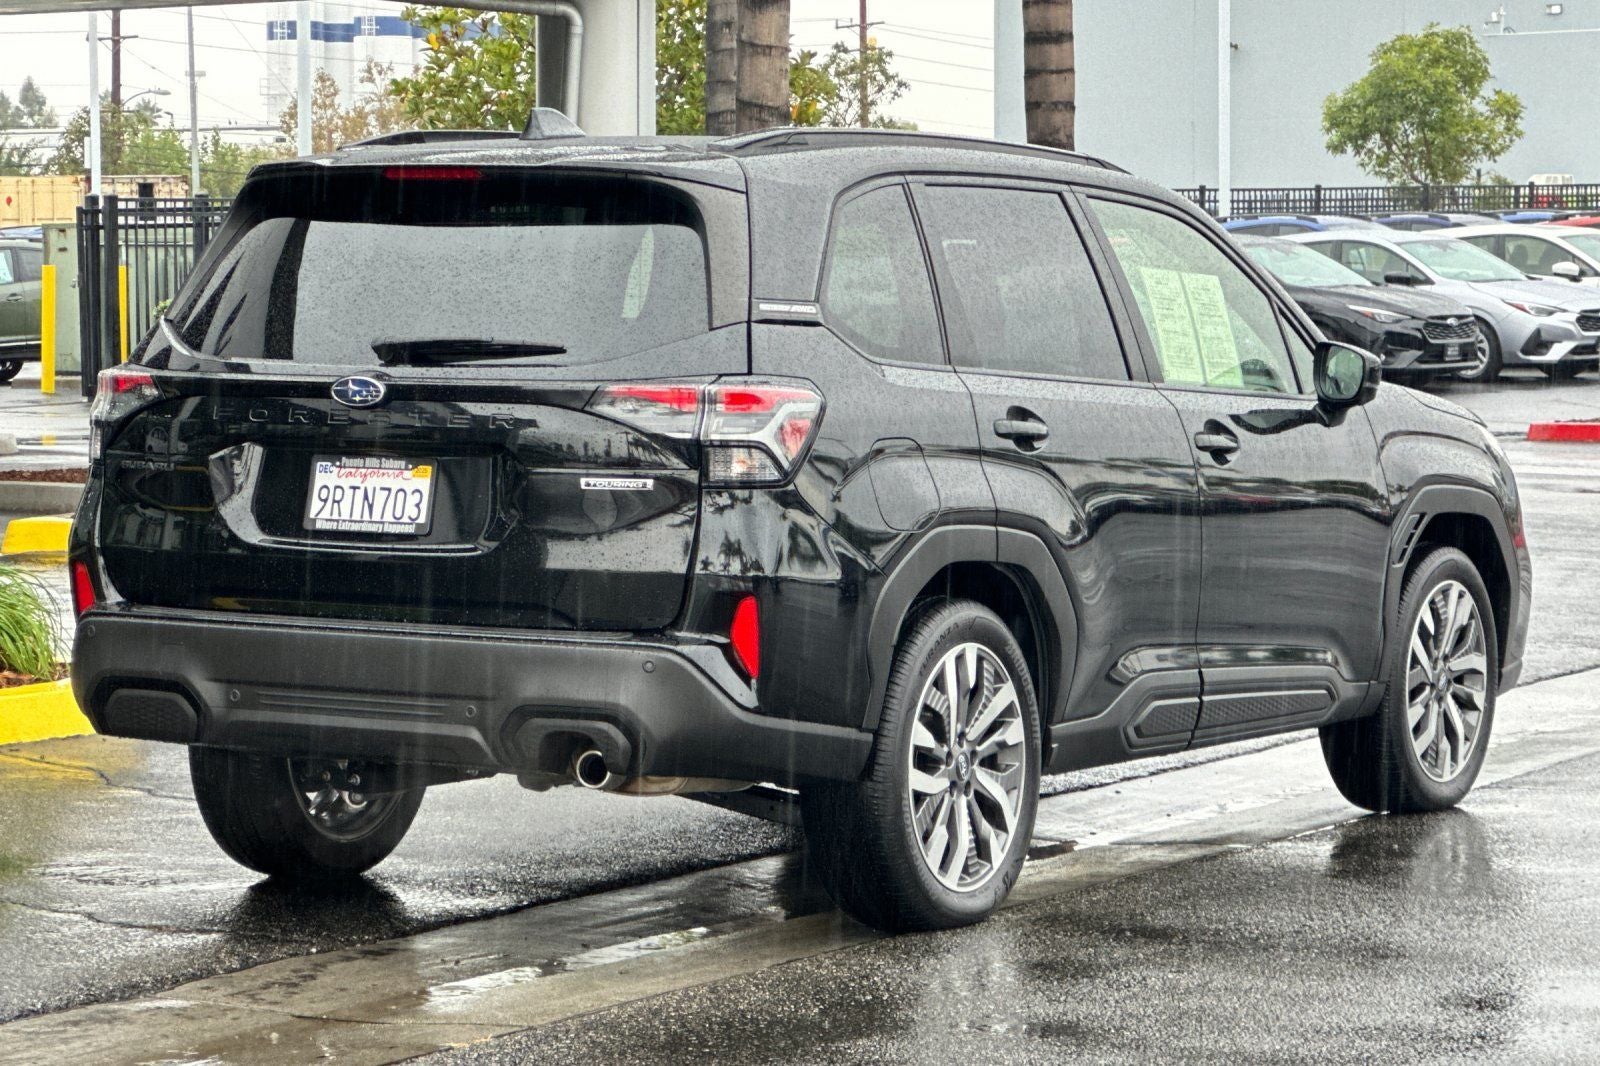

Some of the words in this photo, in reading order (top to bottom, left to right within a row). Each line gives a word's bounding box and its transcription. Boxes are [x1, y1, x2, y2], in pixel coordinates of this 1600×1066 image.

[213, 404, 515, 429] FORESTER
[121, 460, 175, 471] SUBARU
[318, 463, 334, 474] DEC
[341, 456, 364, 468] Puente
[365, 457, 380, 468] Hills
[381, 458, 406, 469] Subaru
[336, 466, 412, 484] California
[588, 480, 644, 489] TOURING
[314, 484, 424, 522] 9RTN703
[315, 518, 337, 530] Where
[338, 519, 383, 533] Extraordinary
[384, 522, 416, 533] Happens!
[1005, 642, 1041, 750] BRIDGESTONE
